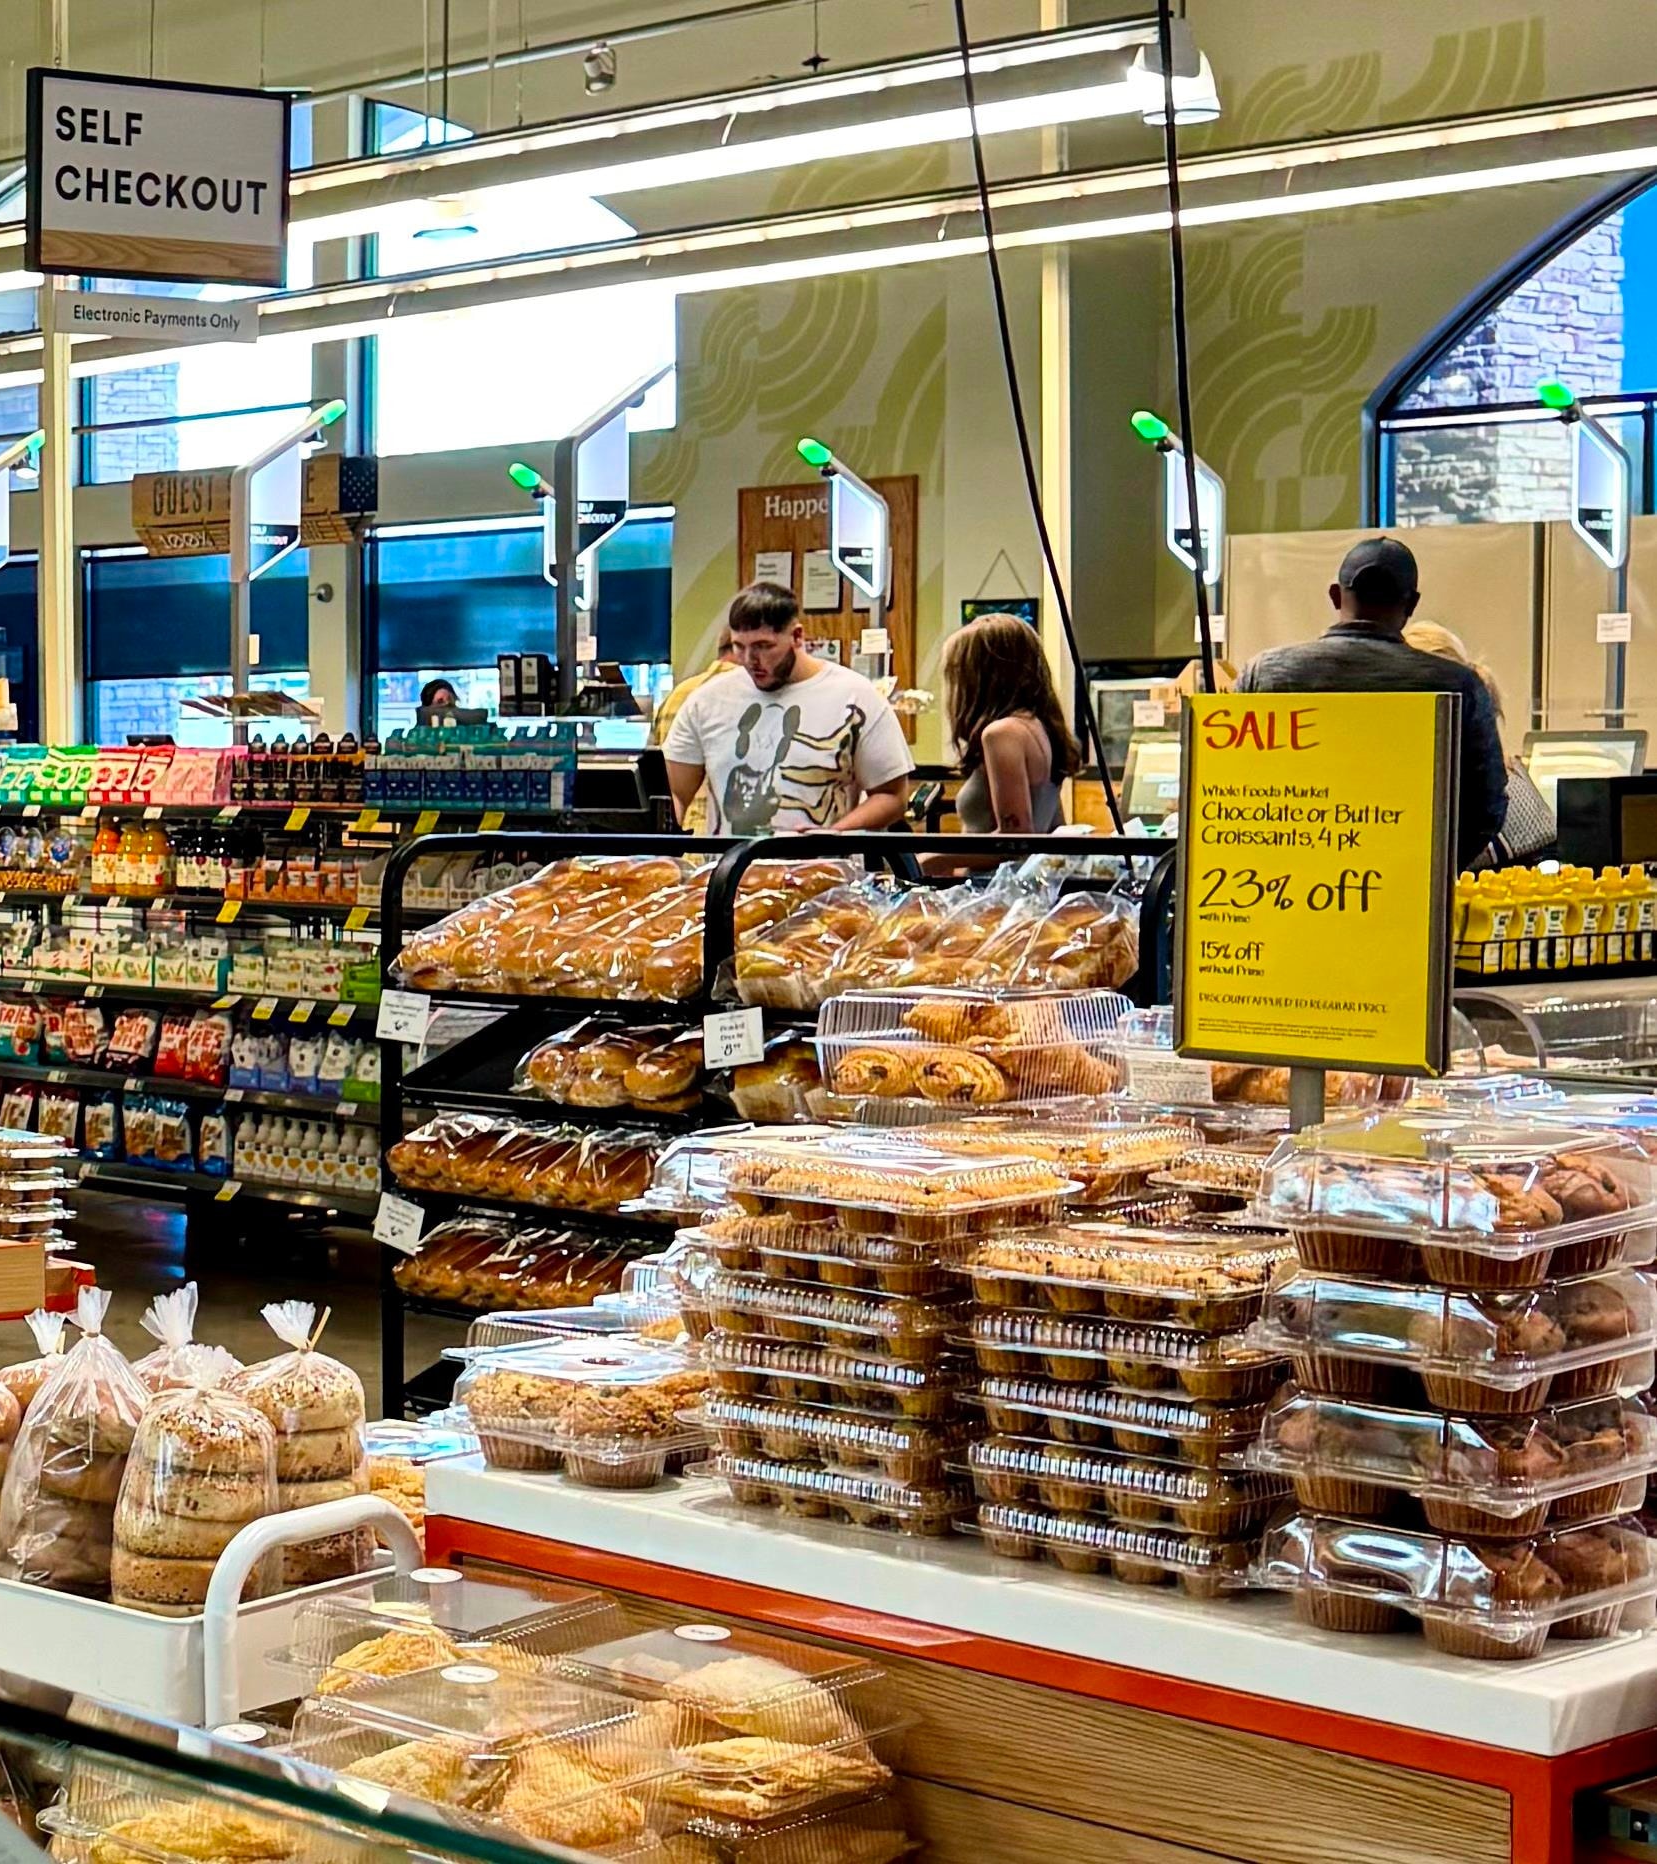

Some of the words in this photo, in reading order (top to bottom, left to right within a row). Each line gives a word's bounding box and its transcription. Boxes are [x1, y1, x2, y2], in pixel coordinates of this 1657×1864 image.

[55, 105, 143, 146] SELF
[55, 165, 267, 215] CHECKOUT
[74, 304, 141, 323] Electronic
[144, 309, 207, 328] Payments
[210, 314, 241, 332] Only
[153, 474, 214, 516] GUEST
[1202, 708, 1320, 751] SALE
[1202, 784, 1240, 797] Whole
[1243, 785, 1282, 797] Foods
[1284, 786, 1329, 799] Market
[1202, 801, 1303, 822] Chocolate
[1307, 807, 1332, 823] or
[1335, 803, 1406, 824] Butter
[1201, 825, 1316, 849] Croissants,
[1318, 827, 1332, 847] 4
[1338, 828, 1361, 852] pk
[1198, 867, 1294, 911] 23%
[1306, 868, 1383, 912] off
[1222, 913, 1251, 924] Prime
[1200, 940, 1232, 960] 15%
[1235, 940, 1265, 961] off
[1199, 964, 1234, 976] without
[1236, 965, 1265, 977] Prime
[1199, 992, 1250, 1005] DISCOUNT
